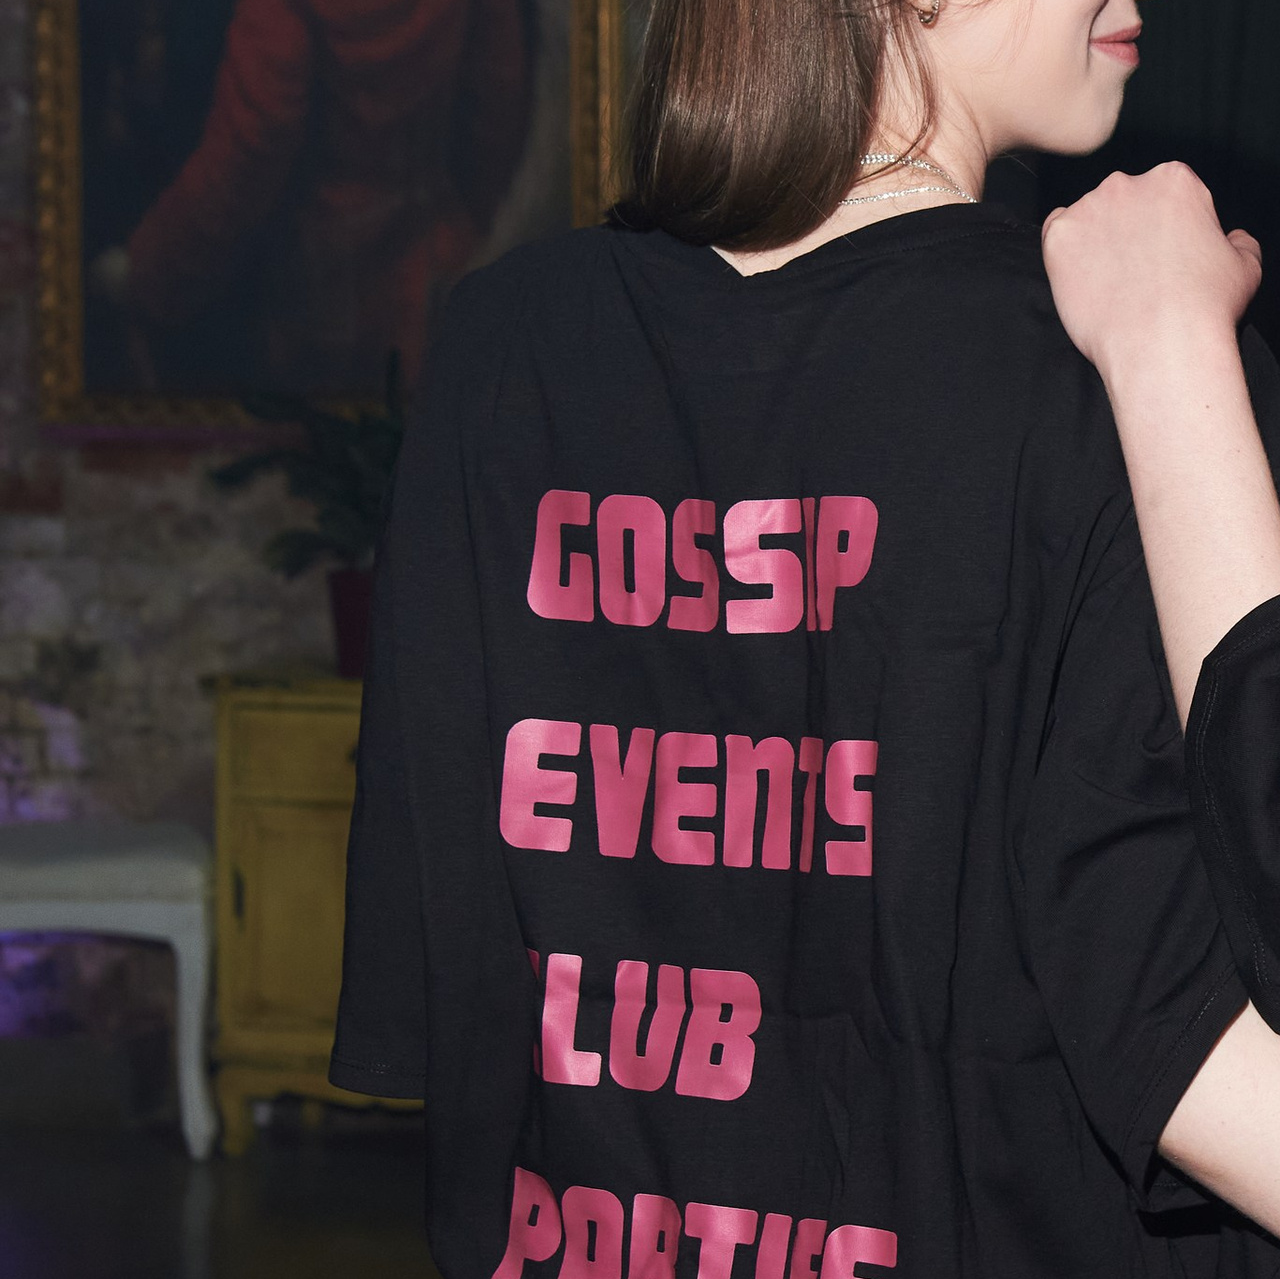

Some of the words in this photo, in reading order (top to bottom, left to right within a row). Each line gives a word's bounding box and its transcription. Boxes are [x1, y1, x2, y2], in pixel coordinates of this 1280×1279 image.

[527, 489, 878, 634] GOSSIP
[499, 718, 878, 876] EVENTS
[526, 948, 762, 1101] LUB
